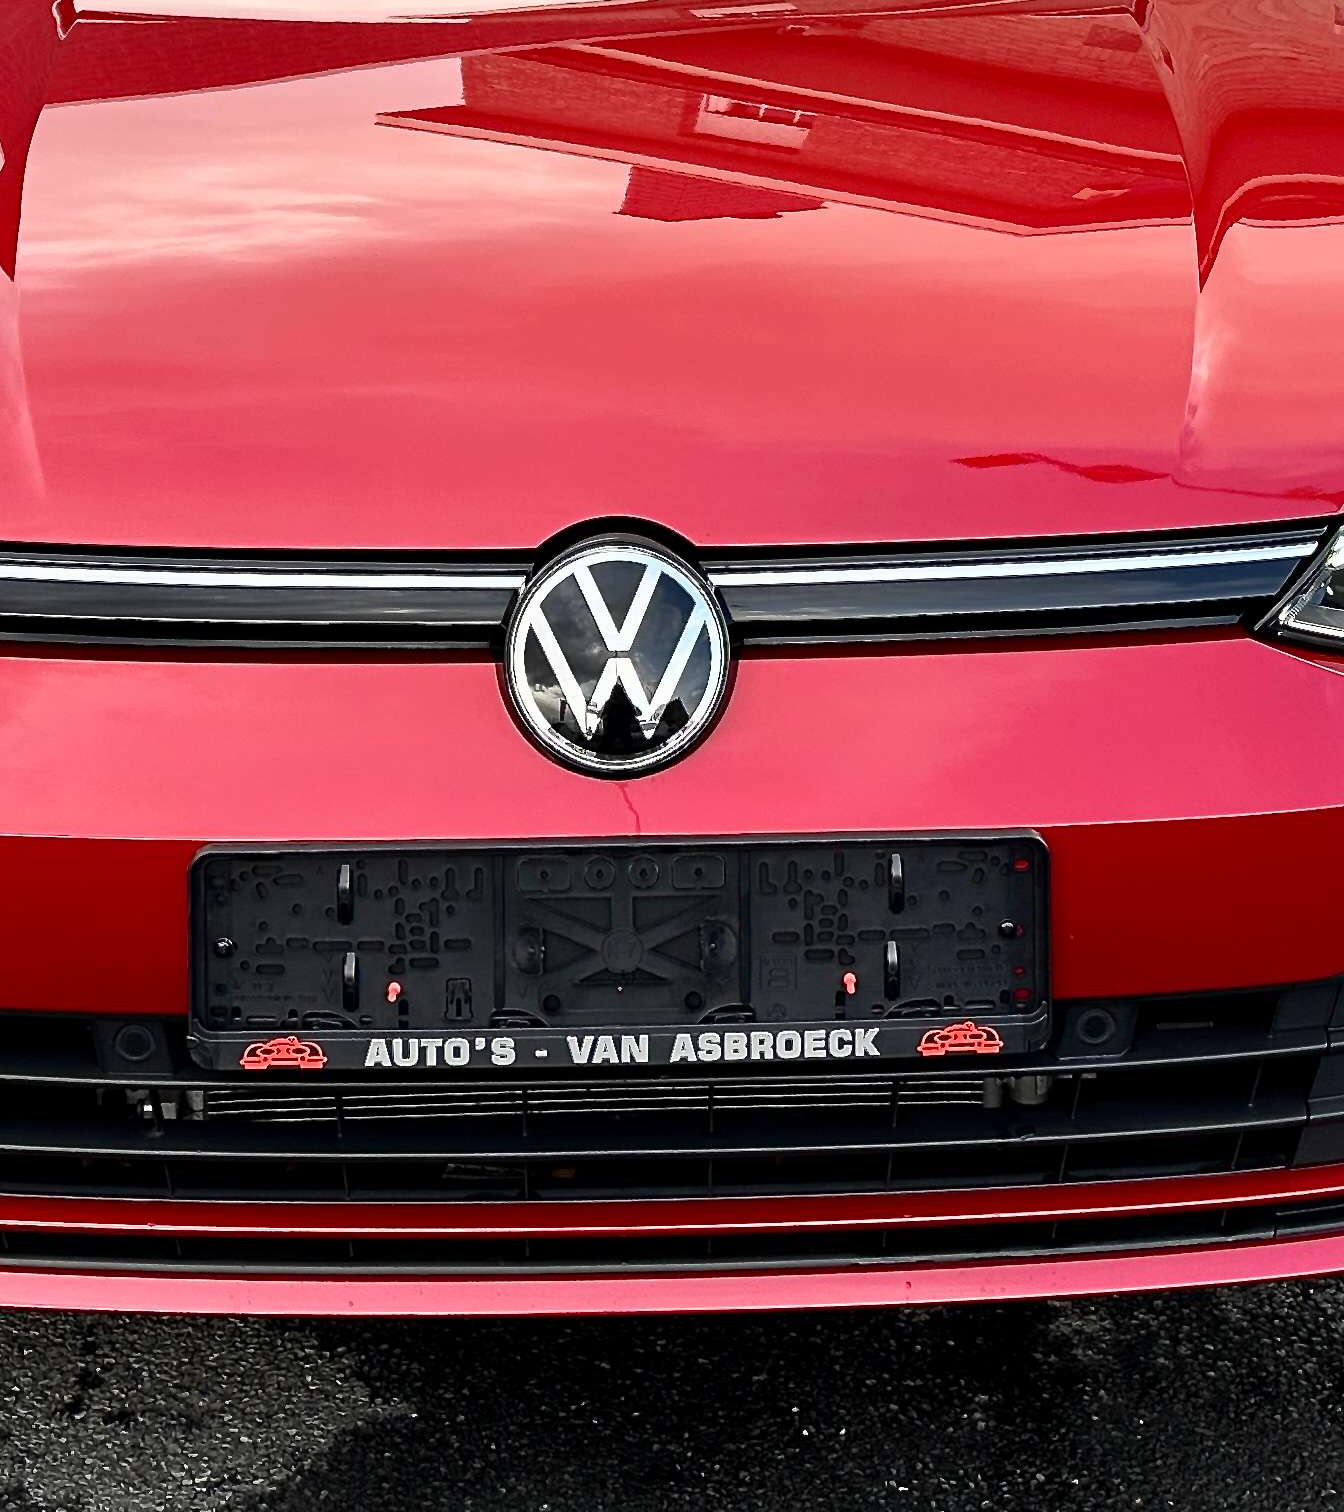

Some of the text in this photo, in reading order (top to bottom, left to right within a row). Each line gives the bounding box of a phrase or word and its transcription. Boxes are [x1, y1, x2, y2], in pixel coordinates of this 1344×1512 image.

[363, 1036, 517, 1068] AUTO'S
[565, 1033, 651, 1065] VAN
[668, 1027, 881, 1065] ASBROECK
